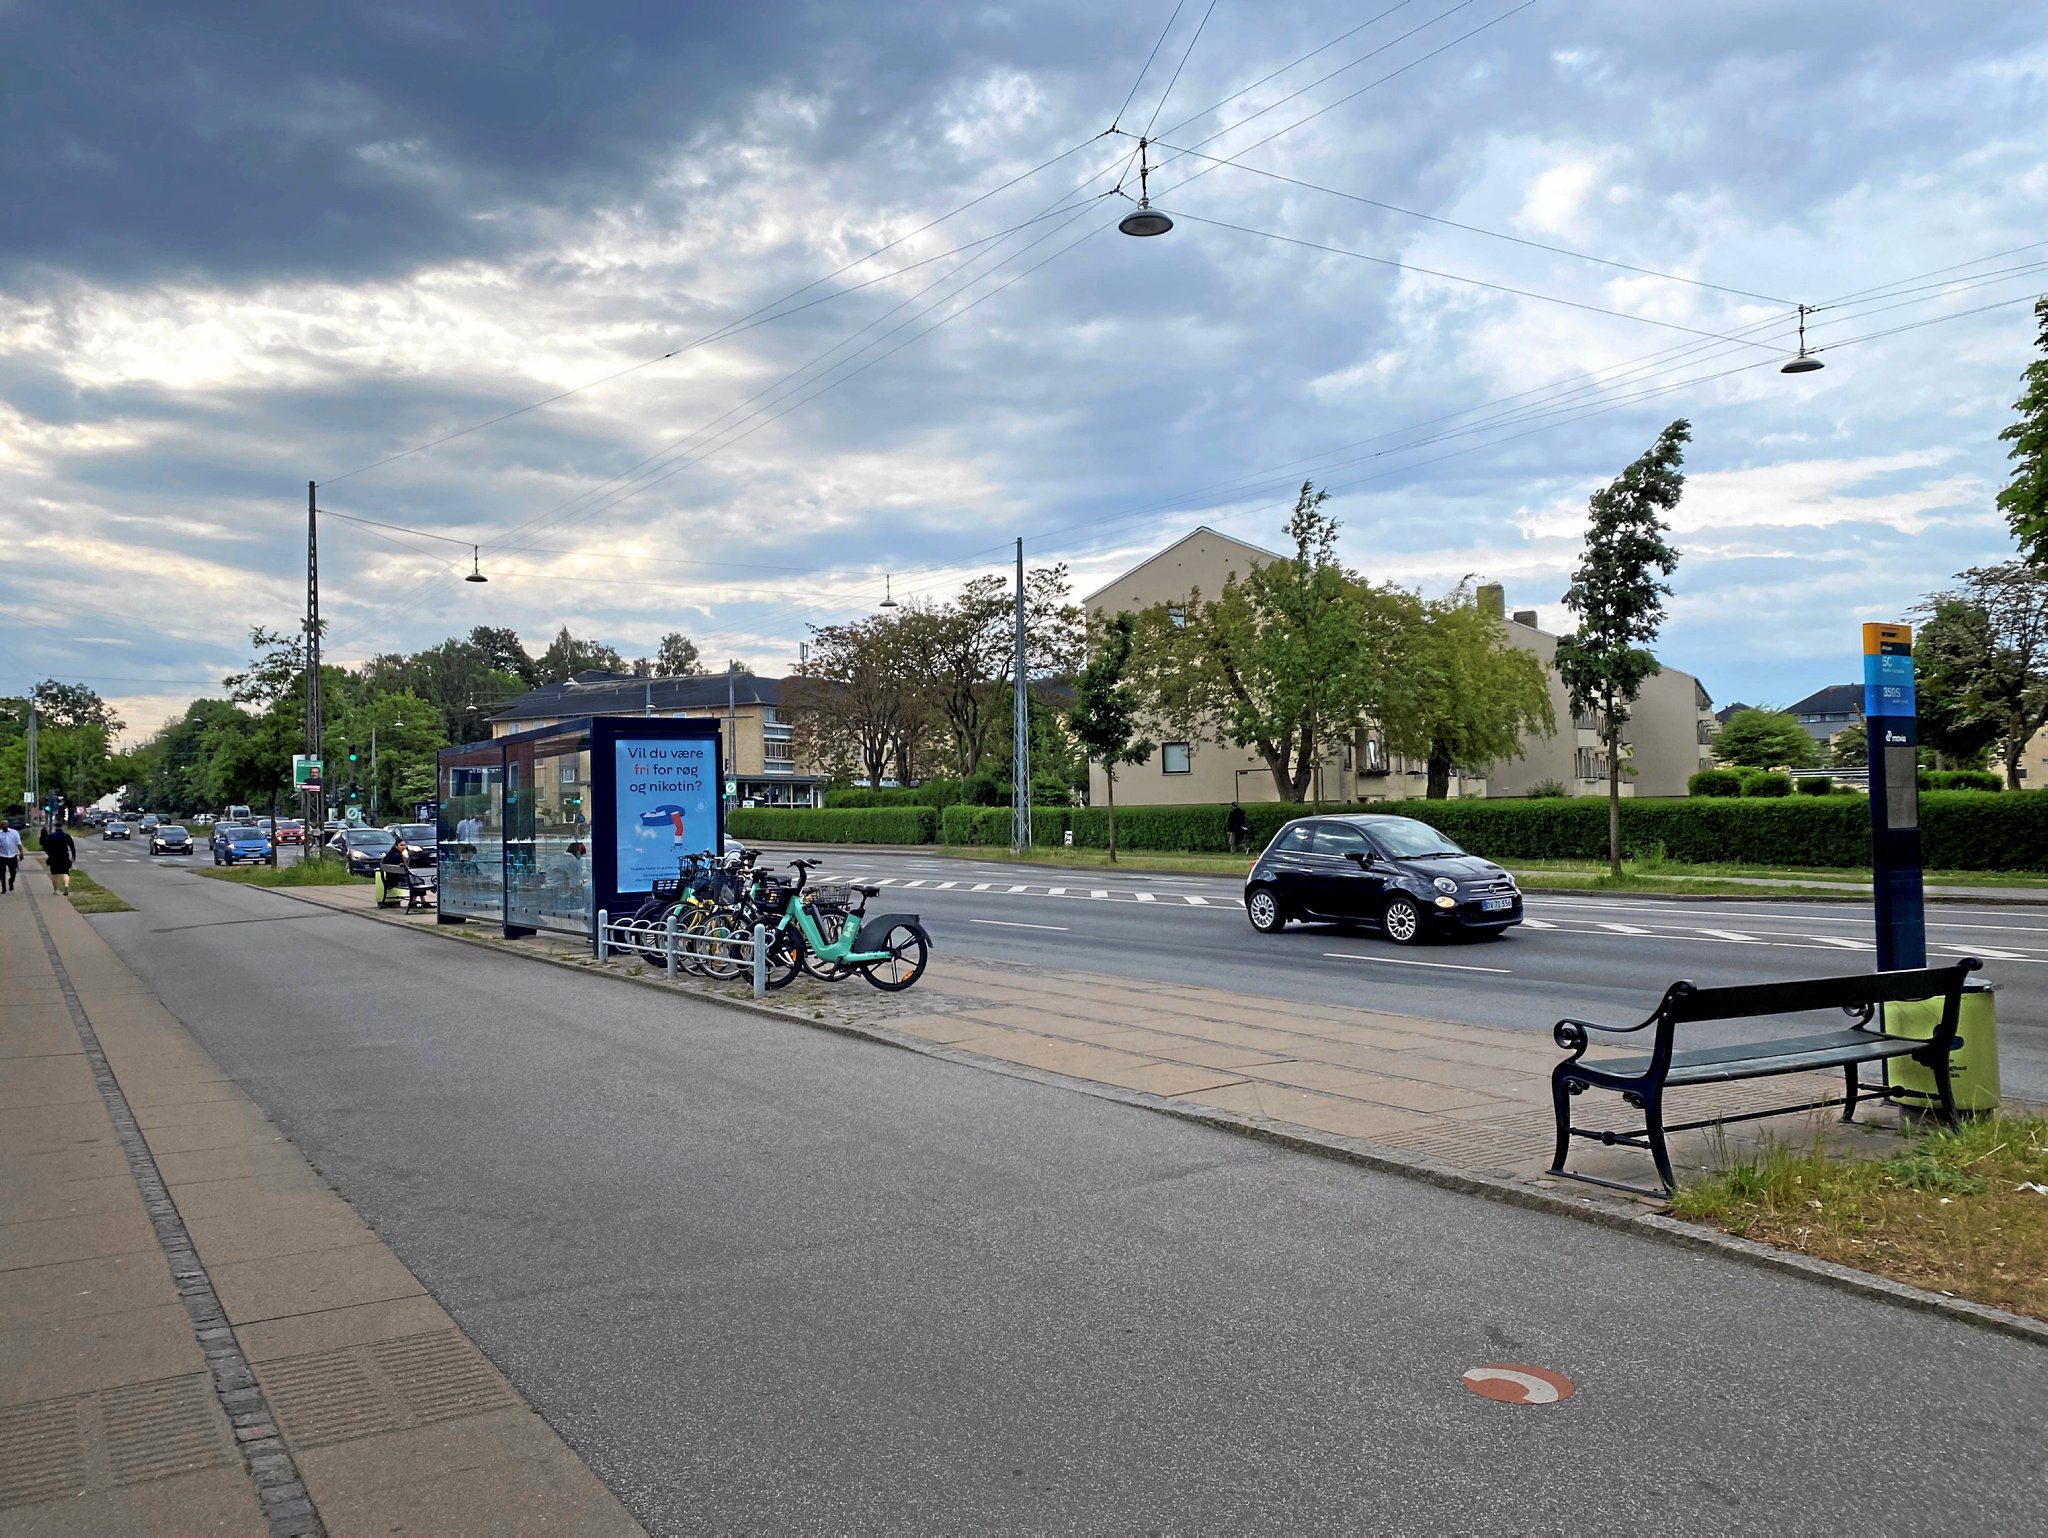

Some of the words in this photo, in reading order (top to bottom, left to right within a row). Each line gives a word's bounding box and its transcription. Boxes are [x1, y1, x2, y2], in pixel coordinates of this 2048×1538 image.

[1882, 656, 1893, 667] 5C
[1883, 687, 1901, 698] 350S
[628, 748, 646, 758] Vil
[650, 748, 667, 758] du
[671, 750, 704, 759] være
[634, 764, 649, 775] fri
[653, 764, 673, 775] for
[676, 766, 698, 777] røg
[630, 783, 646, 795] og
[650, 781, 702, 792] nikotin?
[843, 921, 855, 938] Bolt
